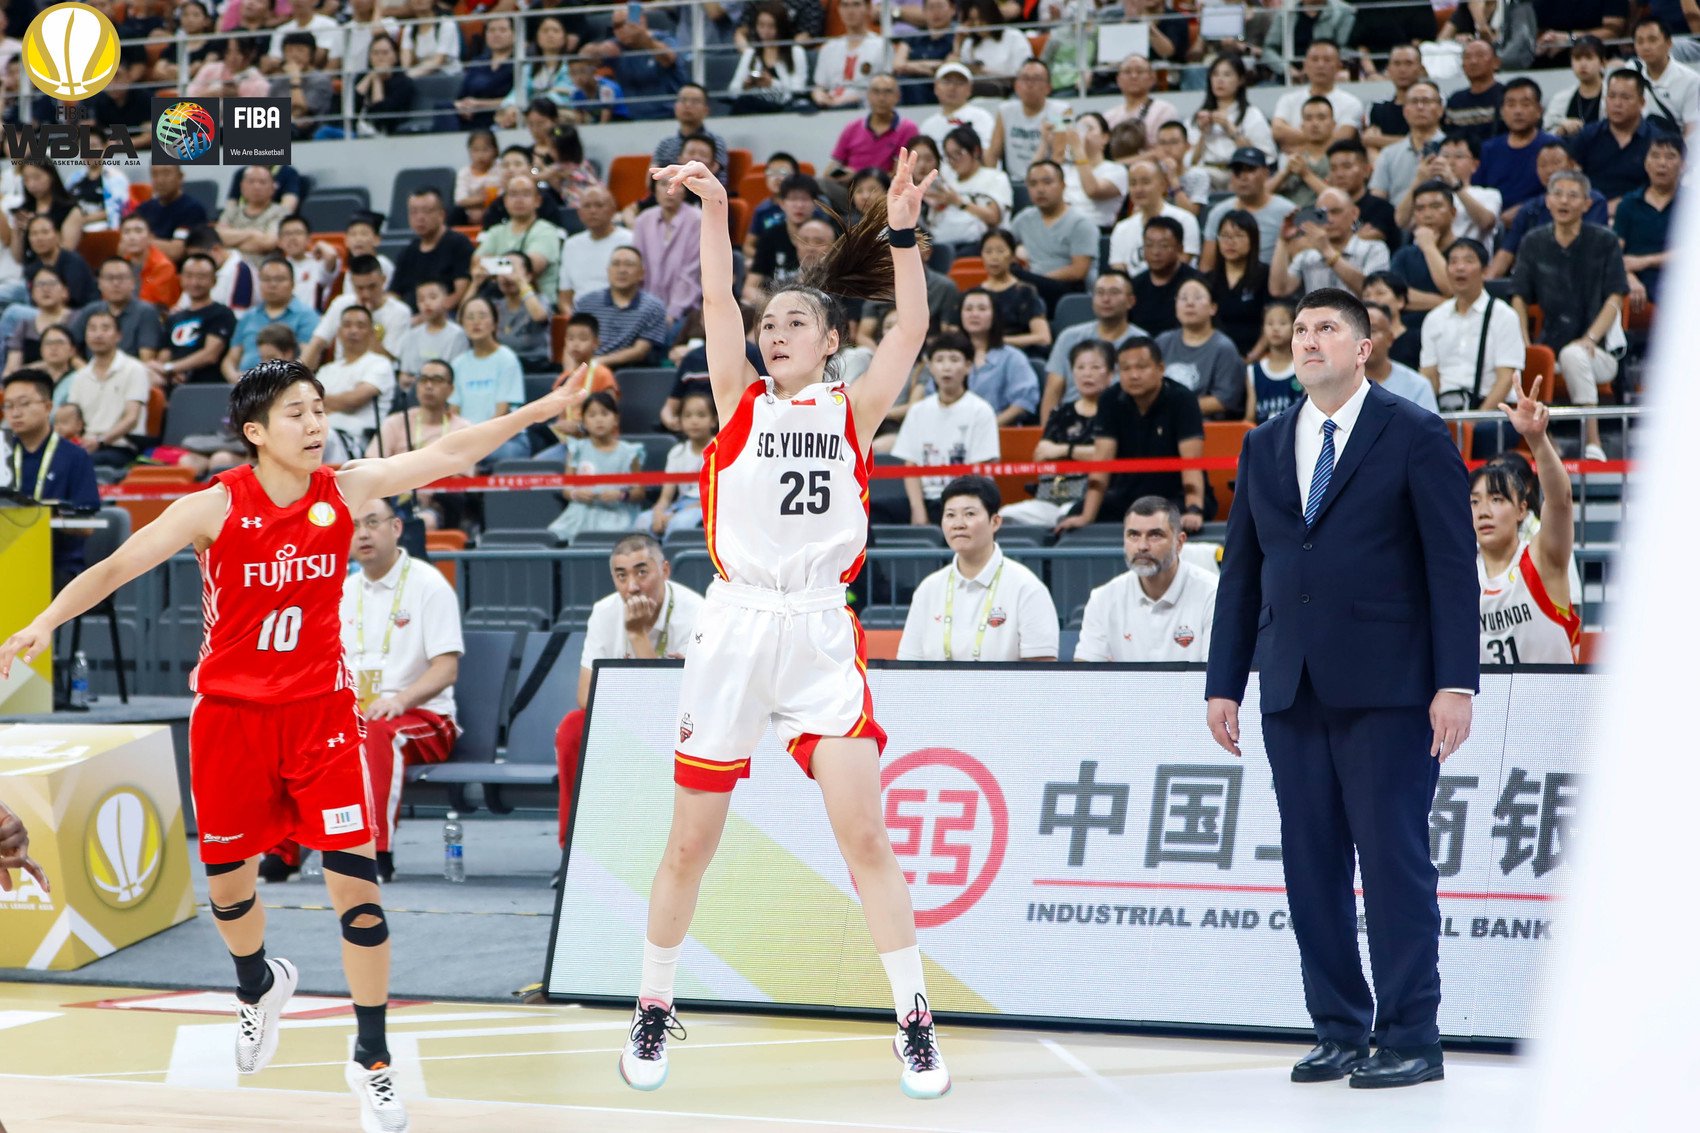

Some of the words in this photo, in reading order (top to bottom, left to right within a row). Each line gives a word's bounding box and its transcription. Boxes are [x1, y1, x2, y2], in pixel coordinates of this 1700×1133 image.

[780, 470, 831, 515] 25
[243, 544, 336, 592] FUJITSU
[256, 606, 303, 652] 10
[1486, 636, 1520, 665] 31
[1026, 903, 1192, 928] INDUSTRIAL
[1200, 908, 1260, 930] AND
